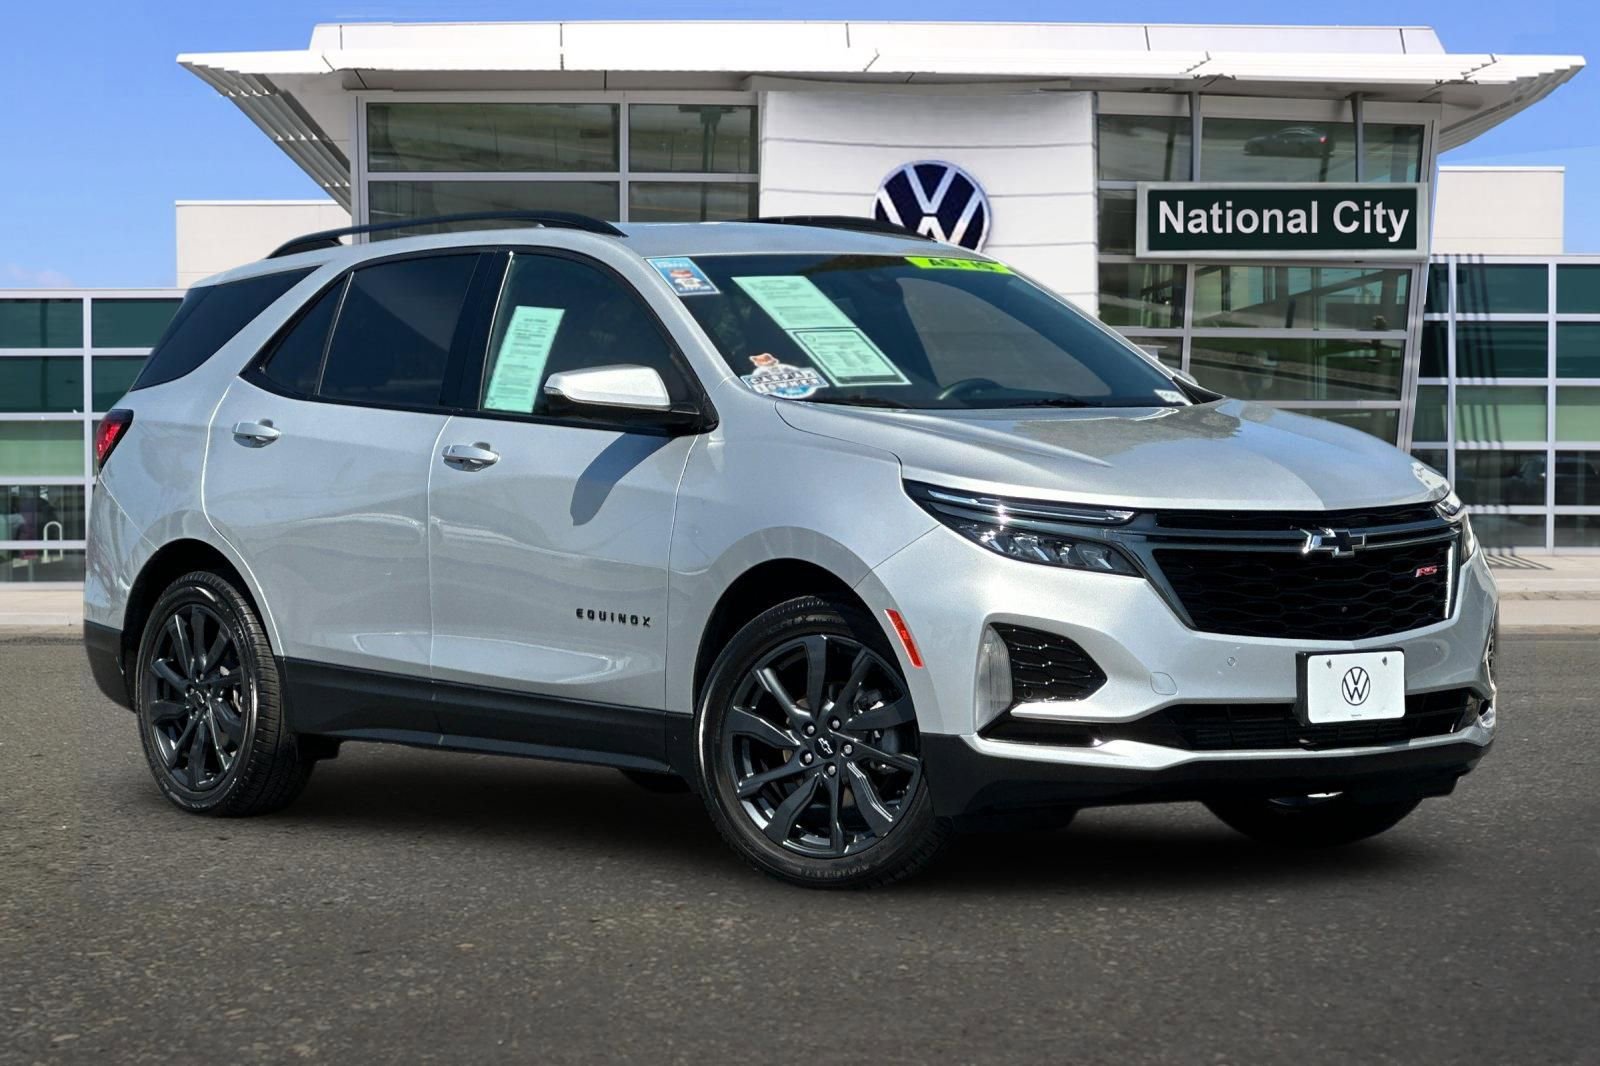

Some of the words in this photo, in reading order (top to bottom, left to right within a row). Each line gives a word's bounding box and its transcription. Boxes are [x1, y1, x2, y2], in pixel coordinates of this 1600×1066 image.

[1158, 200, 1318, 234] National
[1332, 200, 1409, 243] City
[576, 607, 651, 628] EQUINOX
